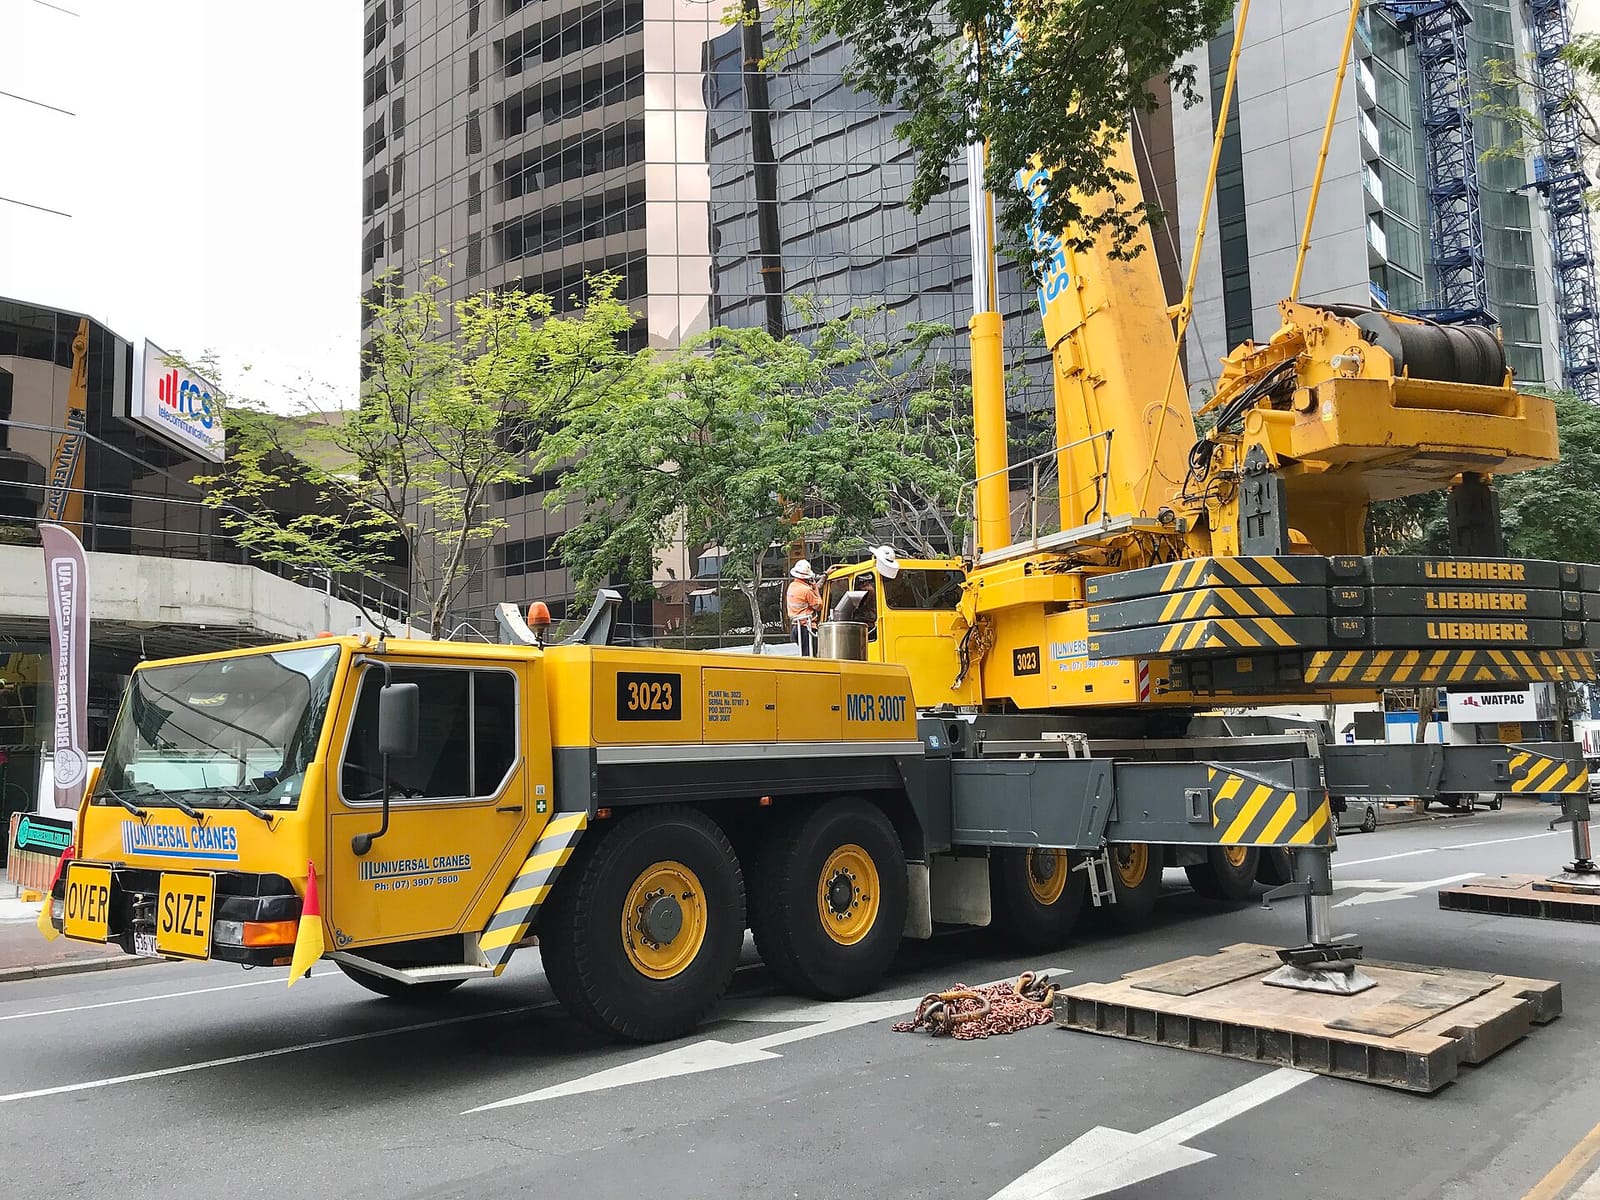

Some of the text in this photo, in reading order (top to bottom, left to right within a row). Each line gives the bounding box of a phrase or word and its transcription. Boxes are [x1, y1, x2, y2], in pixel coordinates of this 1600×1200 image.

[158, 403, 215, 446] telecommunication
[1425, 562, 1525, 581] LIEBHERR
[1426, 592, 1527, 610] LIEBHERR
[1427, 622, 1528, 640] LIEBHERR
[1056, 640, 1088, 655] UNIVERS
[1016, 652, 1037, 671] 3023
[627, 681, 673, 711] 3023
[1481, 694, 1525, 705] WATPAC
[846, 693, 906, 722] MCR 300T
[133, 822, 238, 851] UNIVERSAL CRANES
[373, 854, 471, 874] UNIVERSAL CRANES
[374, 874, 458, 891] Ph: (07) 3907 5800
[68, 882, 109, 924] OVER
[162, 891, 206, 937] SIZE
